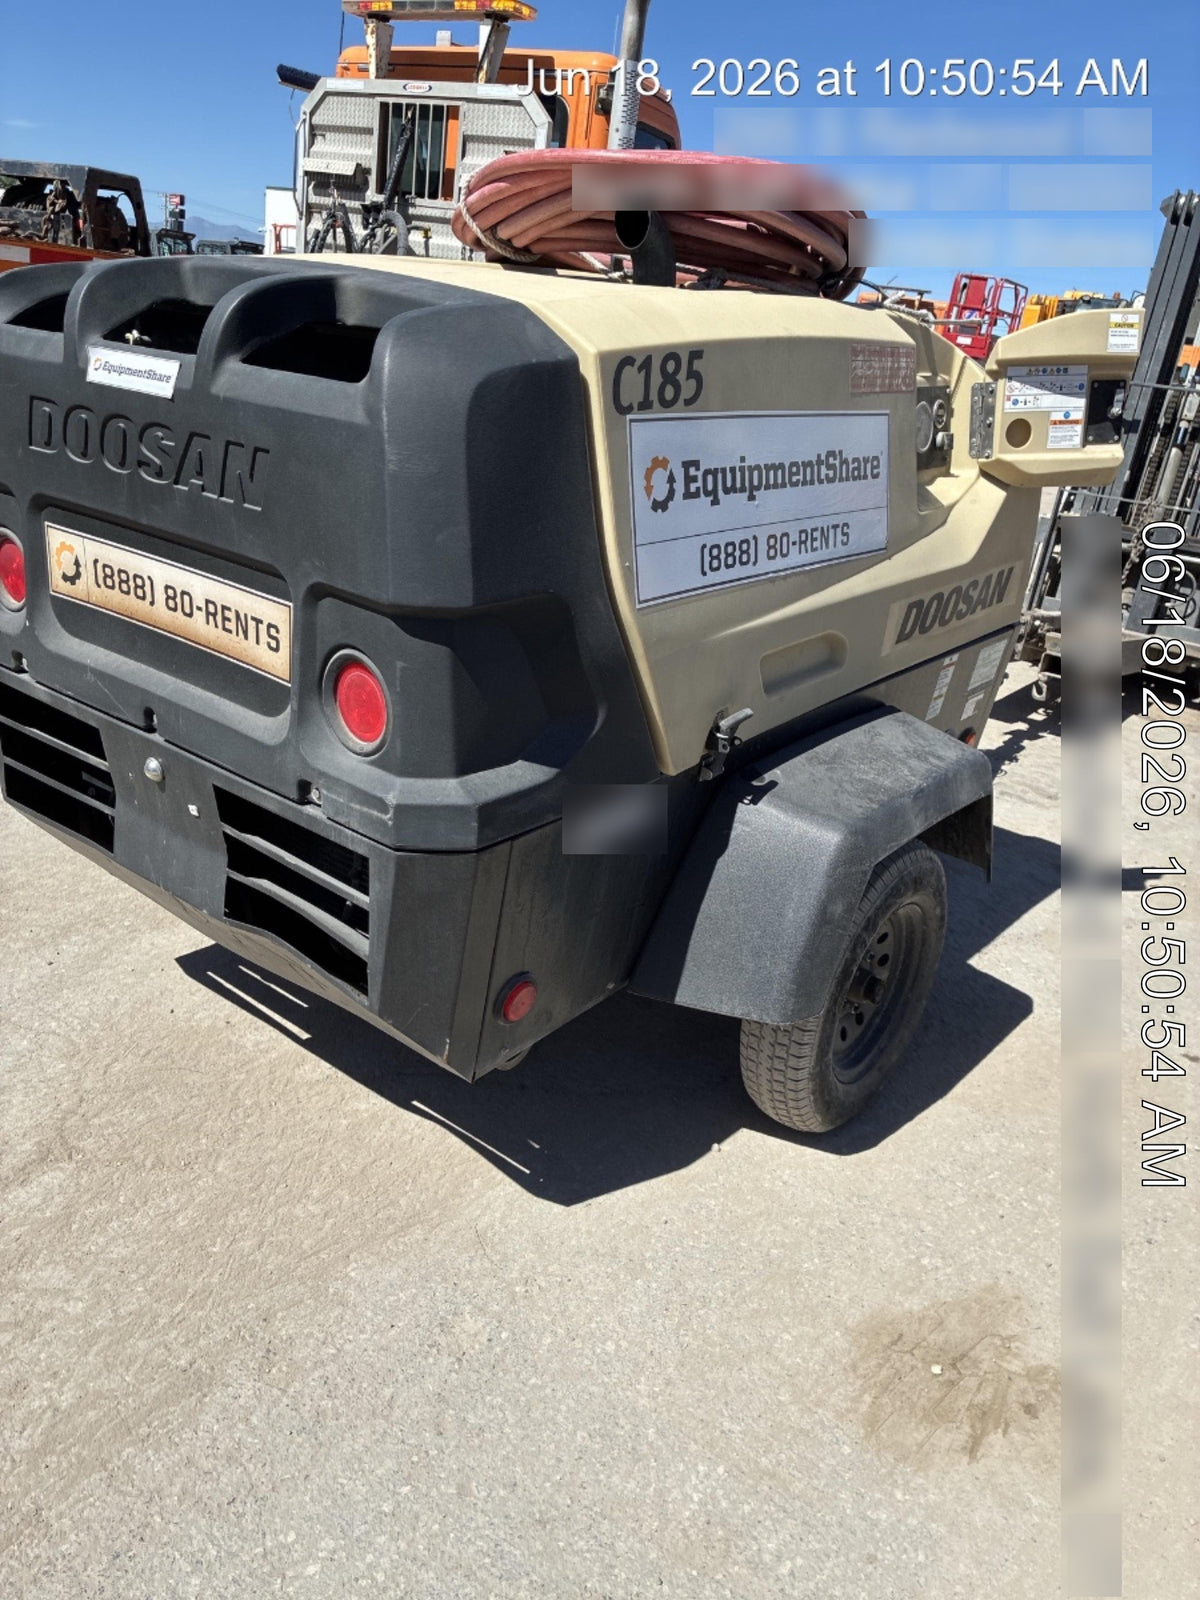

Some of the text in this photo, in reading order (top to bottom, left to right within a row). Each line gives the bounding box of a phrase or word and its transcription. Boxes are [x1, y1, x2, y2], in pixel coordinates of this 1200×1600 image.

[102, 361, 172, 384] EquipmentShare
[612, 350, 704, 416] C185
[28, 395, 270, 511] DOOSAN
[681, 450, 881, 506] EquipmentShare
[700, 522, 850, 577] (888) 80-RENTS
[93, 558, 281, 653] (888) 80-RENTS
[895, 566, 1014, 645] DOOSAN
